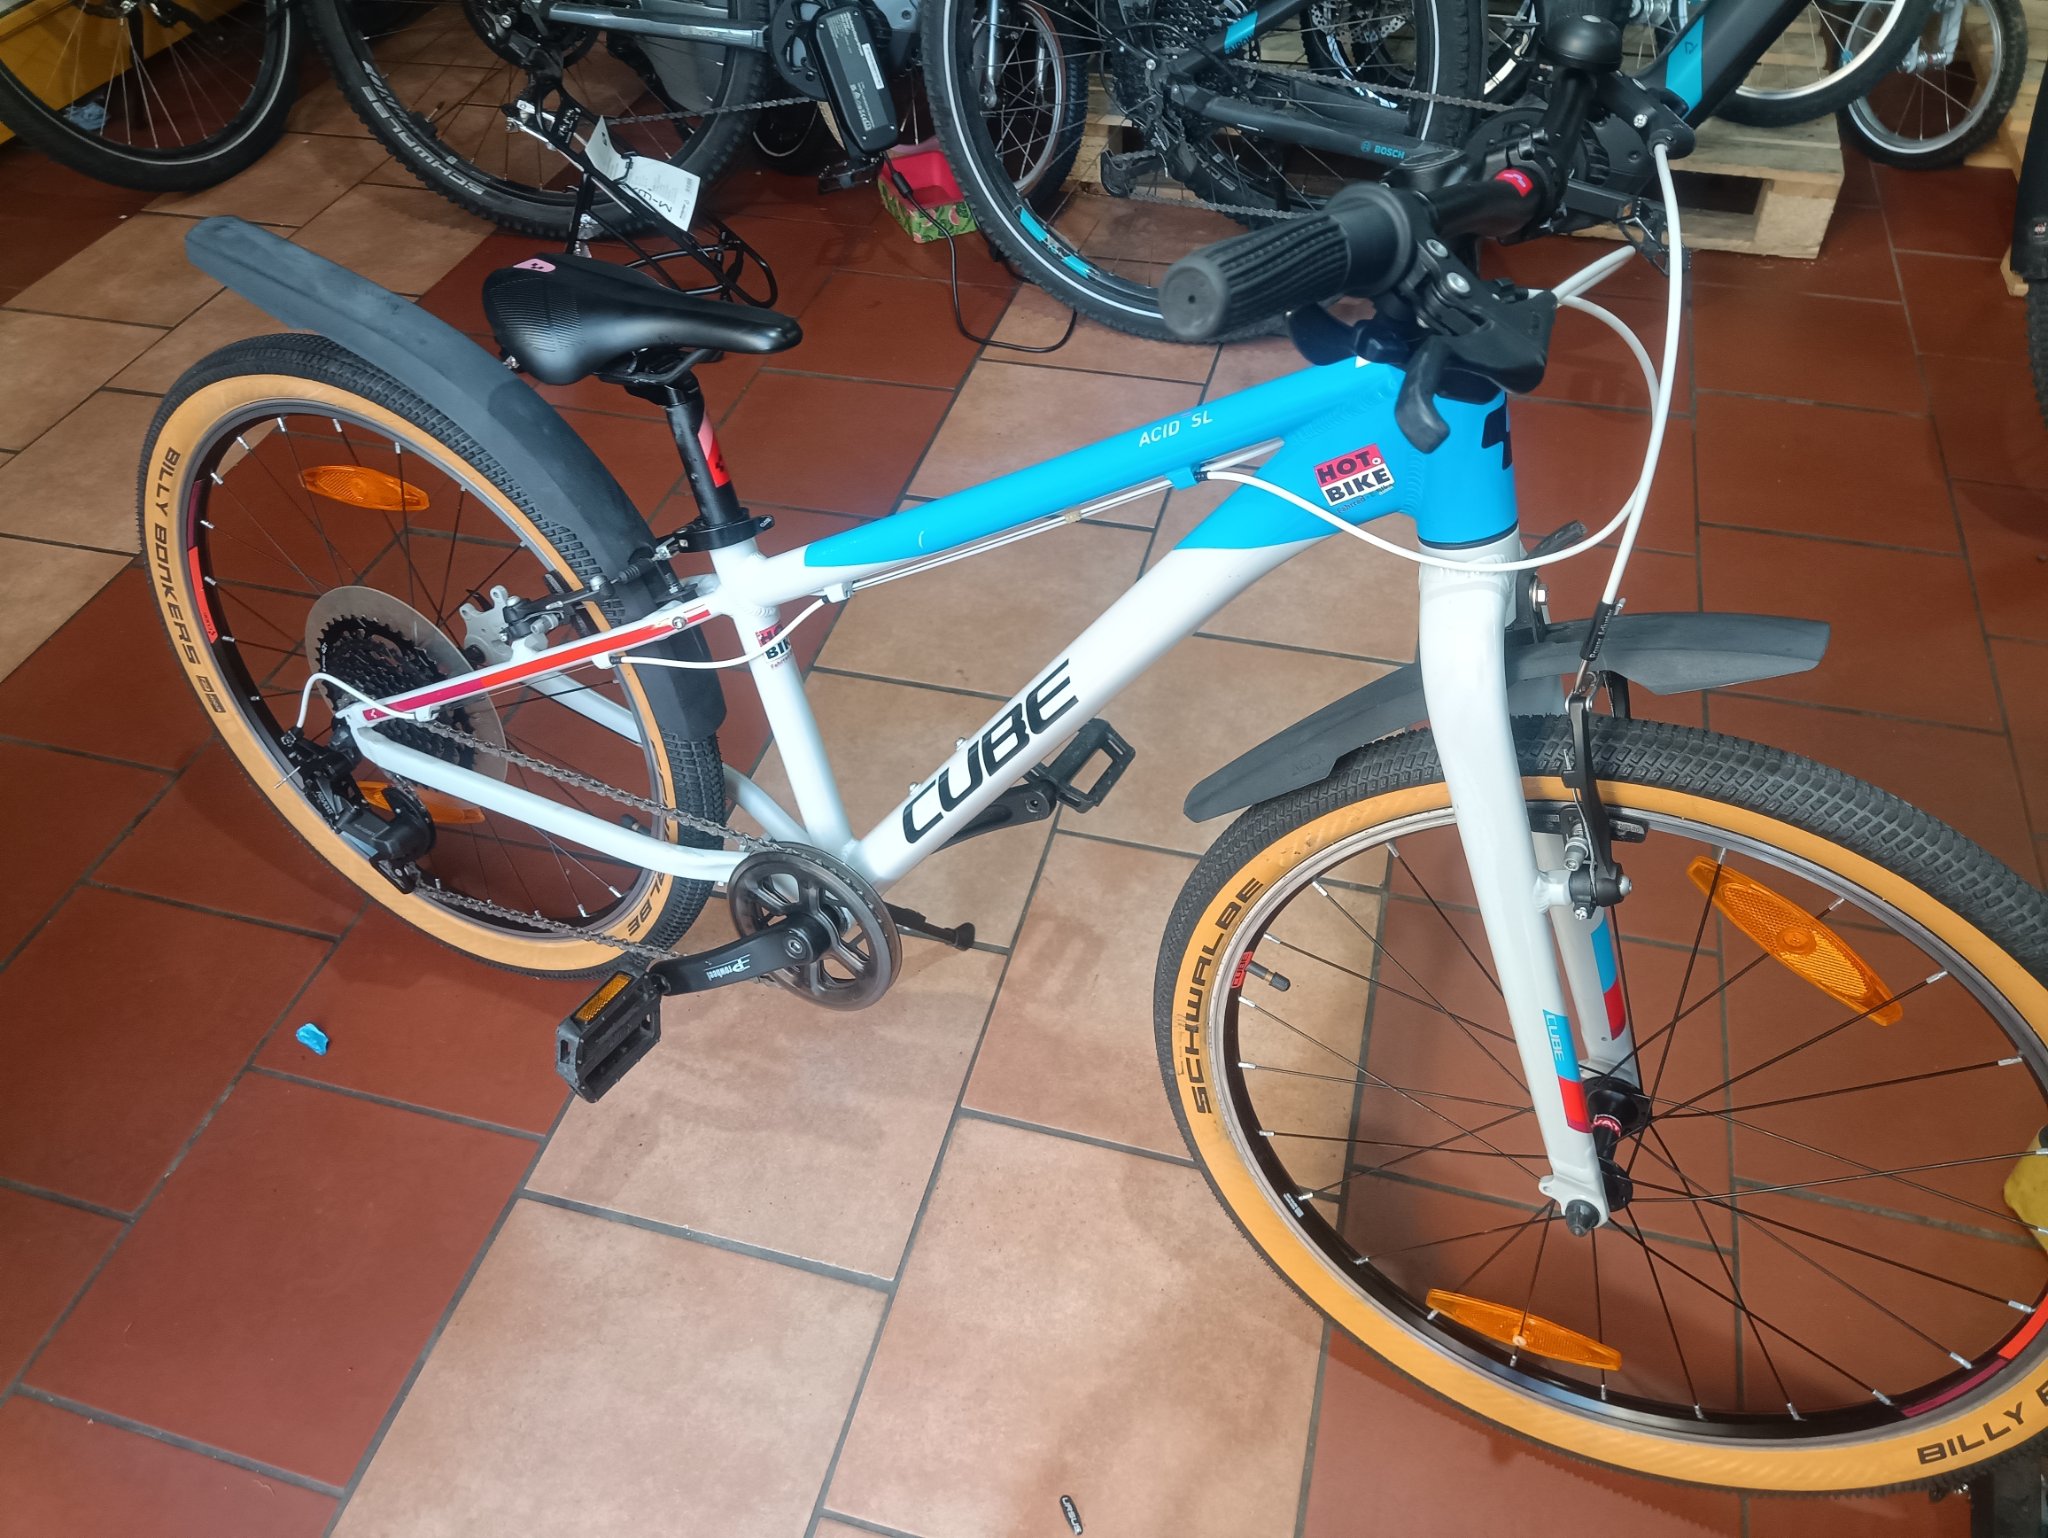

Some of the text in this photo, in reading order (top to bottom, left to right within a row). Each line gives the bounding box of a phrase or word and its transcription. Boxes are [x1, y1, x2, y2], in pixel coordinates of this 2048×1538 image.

[361, 86, 486, 194] SCHWALBE
[1374, 144, 1405, 159] BOSCH
[1138, 410, 1213, 448] ACID SL
[1325, 467, 1391, 503] BIKE
[154, 446, 201, 665] BILLY BONKERS
[902, 658, 1080, 844] CUBE
[1184, 877, 1264, 1114] SCHWALBE
[1546, 1014, 1565, 1062] CUBE
[1916, 1401, 2024, 1465] BILLY
